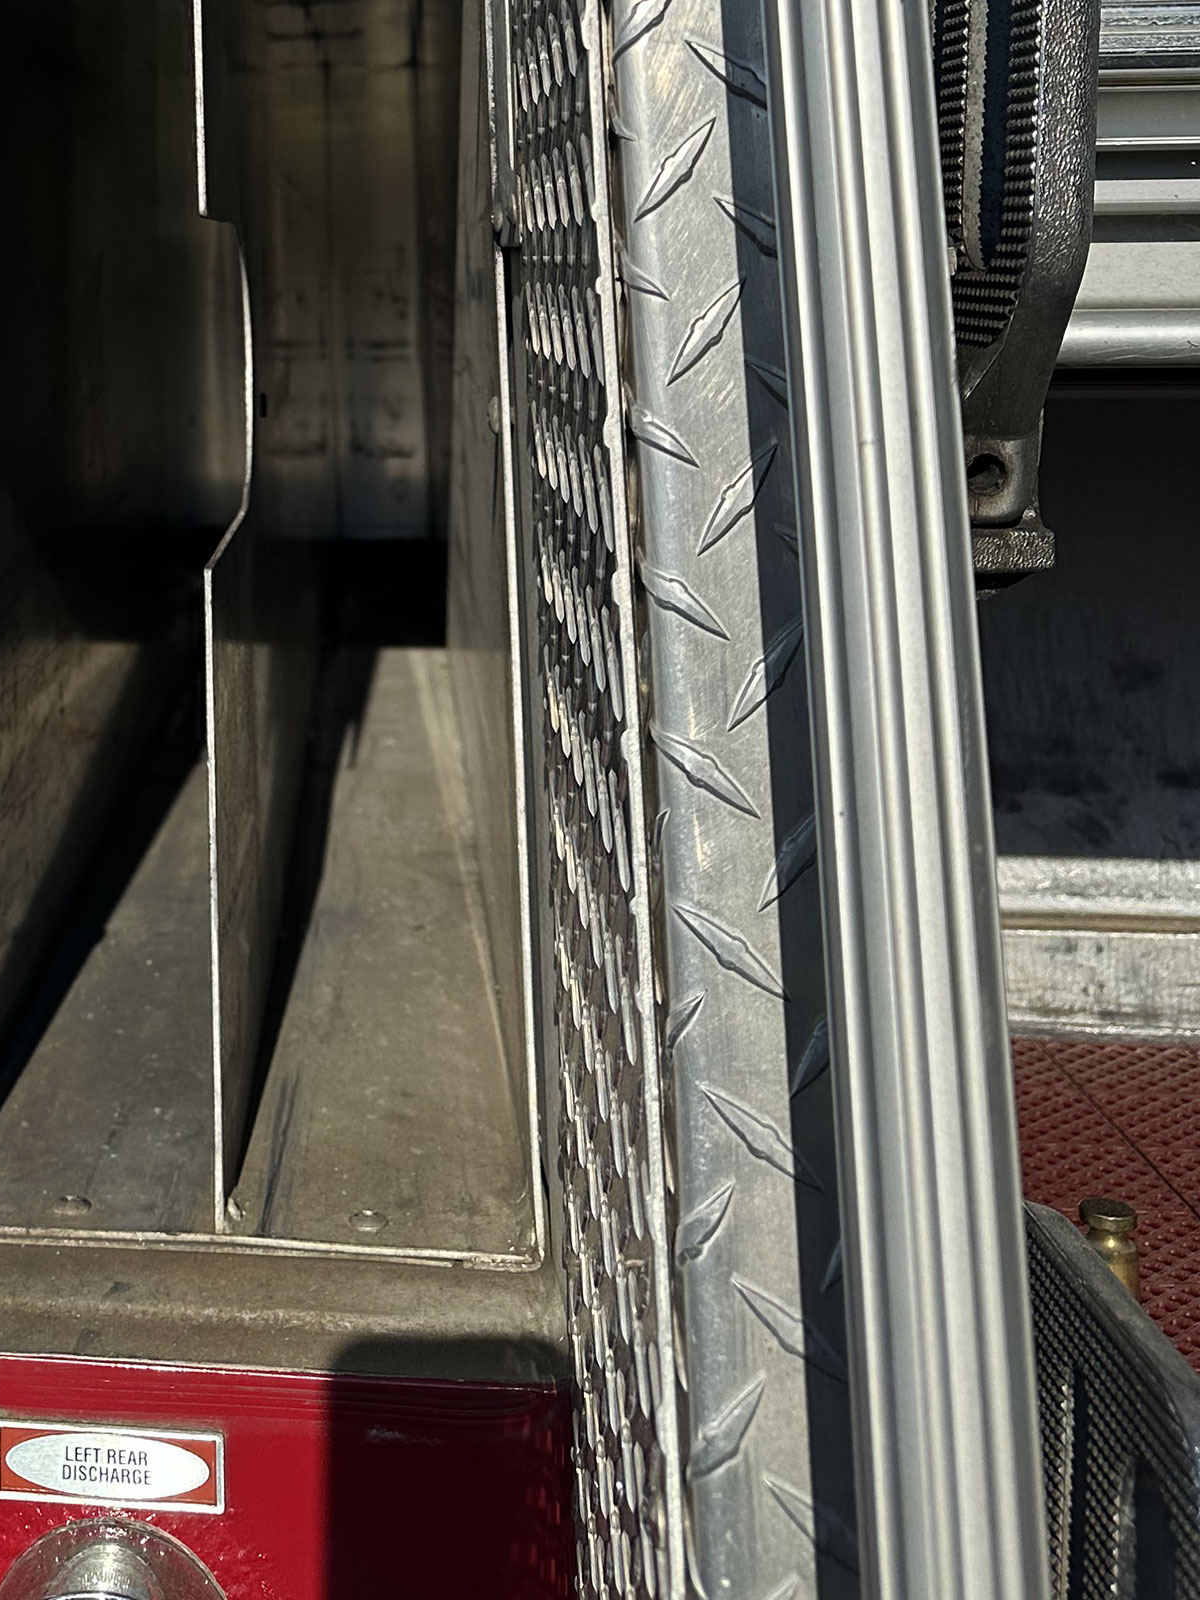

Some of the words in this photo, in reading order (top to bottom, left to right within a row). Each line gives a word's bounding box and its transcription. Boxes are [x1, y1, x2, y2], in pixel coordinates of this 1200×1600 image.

[65, 1445, 101, 1463] LEFT
[107, 1448, 148, 1466] REAR
[62, 1464, 152, 1486] DISCHARGE
